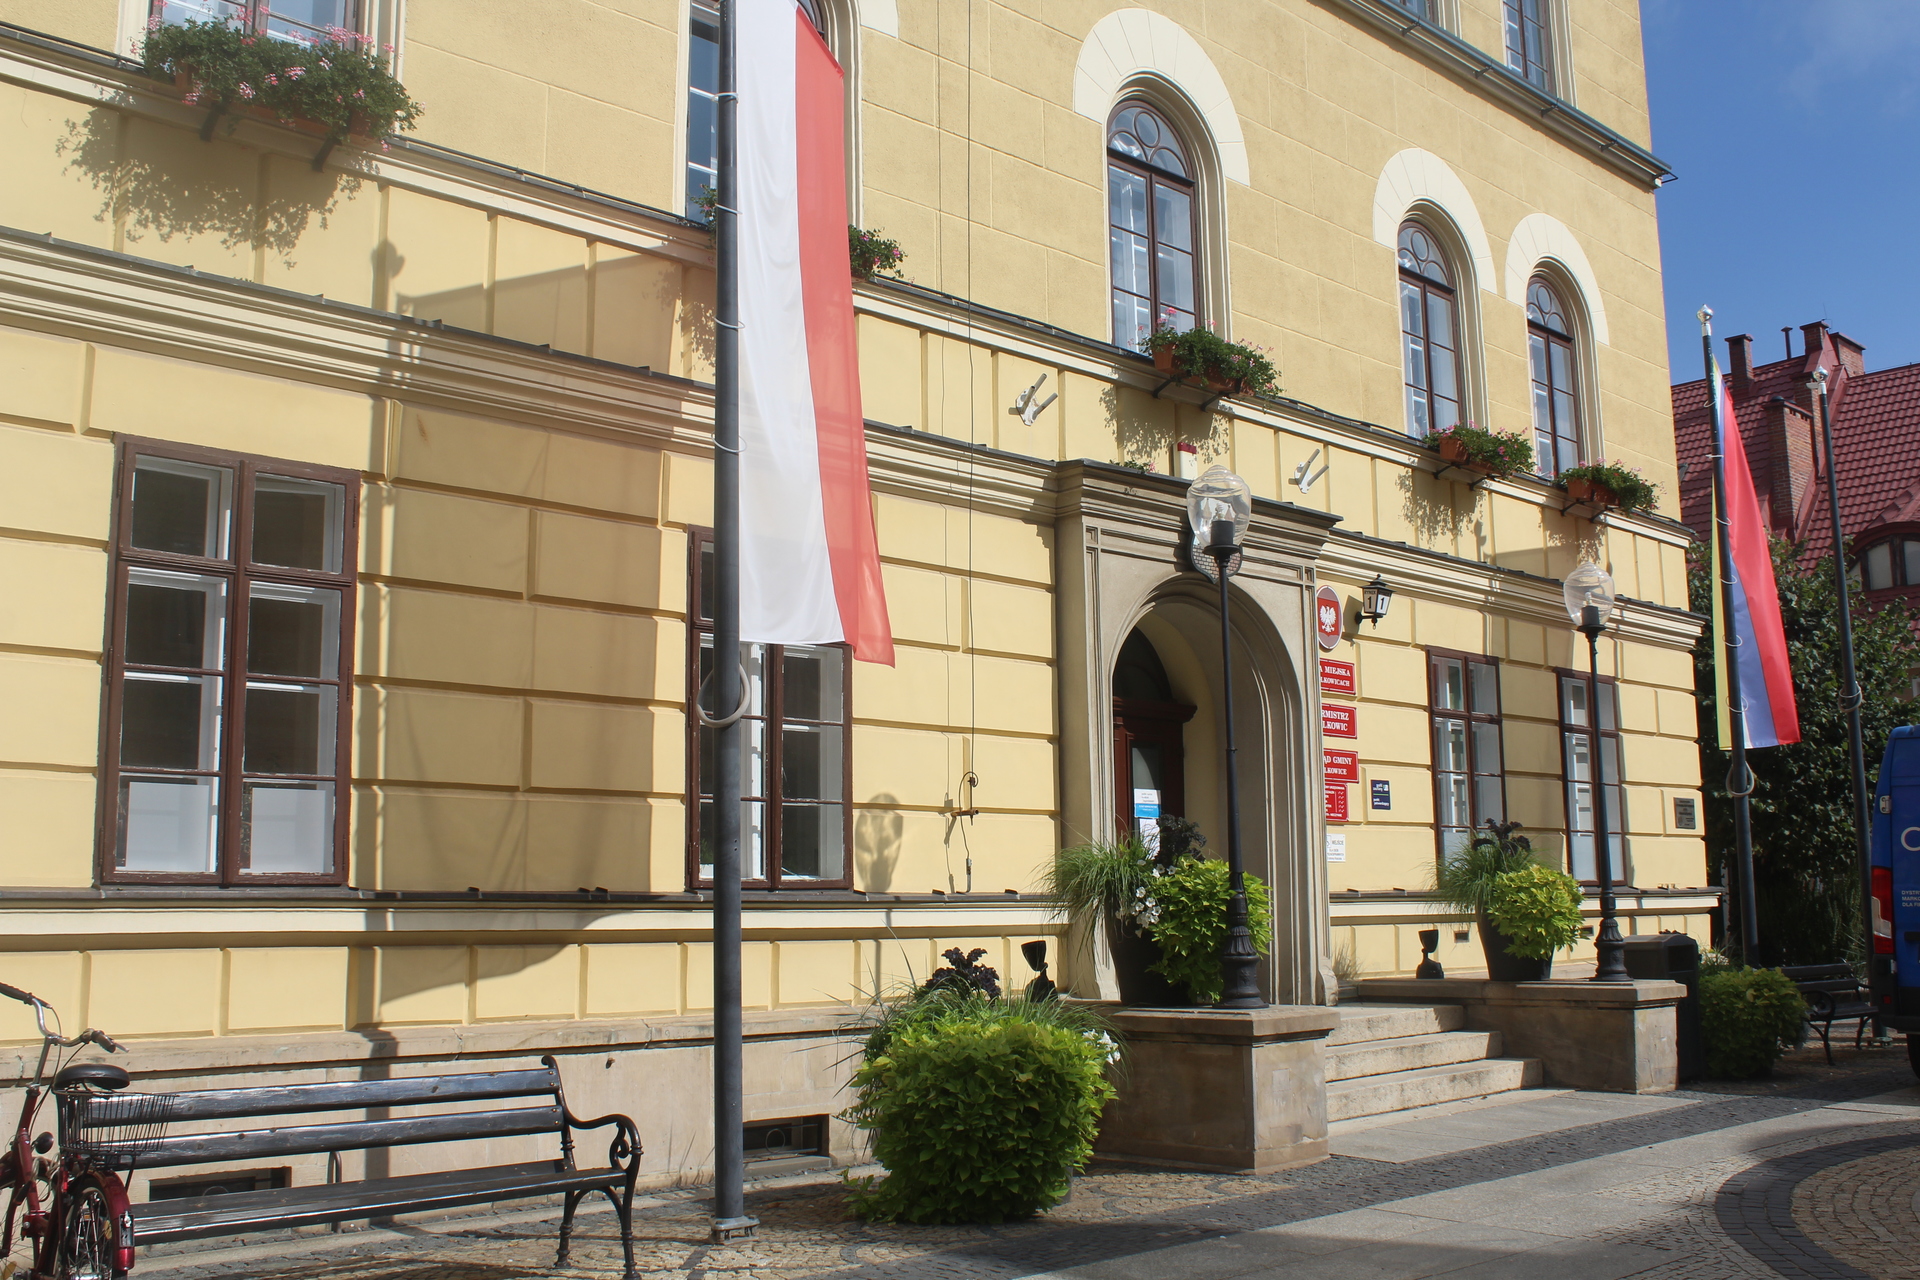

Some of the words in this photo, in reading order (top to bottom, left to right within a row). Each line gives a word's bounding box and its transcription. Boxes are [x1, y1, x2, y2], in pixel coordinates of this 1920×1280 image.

[1367, 596, 1372, 609] 1
[1380, 597, 1385, 610] 1
[1324, 666, 1350, 676] MIEJSKA
[1320, 677, 1350, 686] LKOWICACH
[1322, 709, 1349, 720] RMISTRZ
[1322, 721, 1348, 731] LKOWIC
[1333, 756, 1352, 765] GMINY
